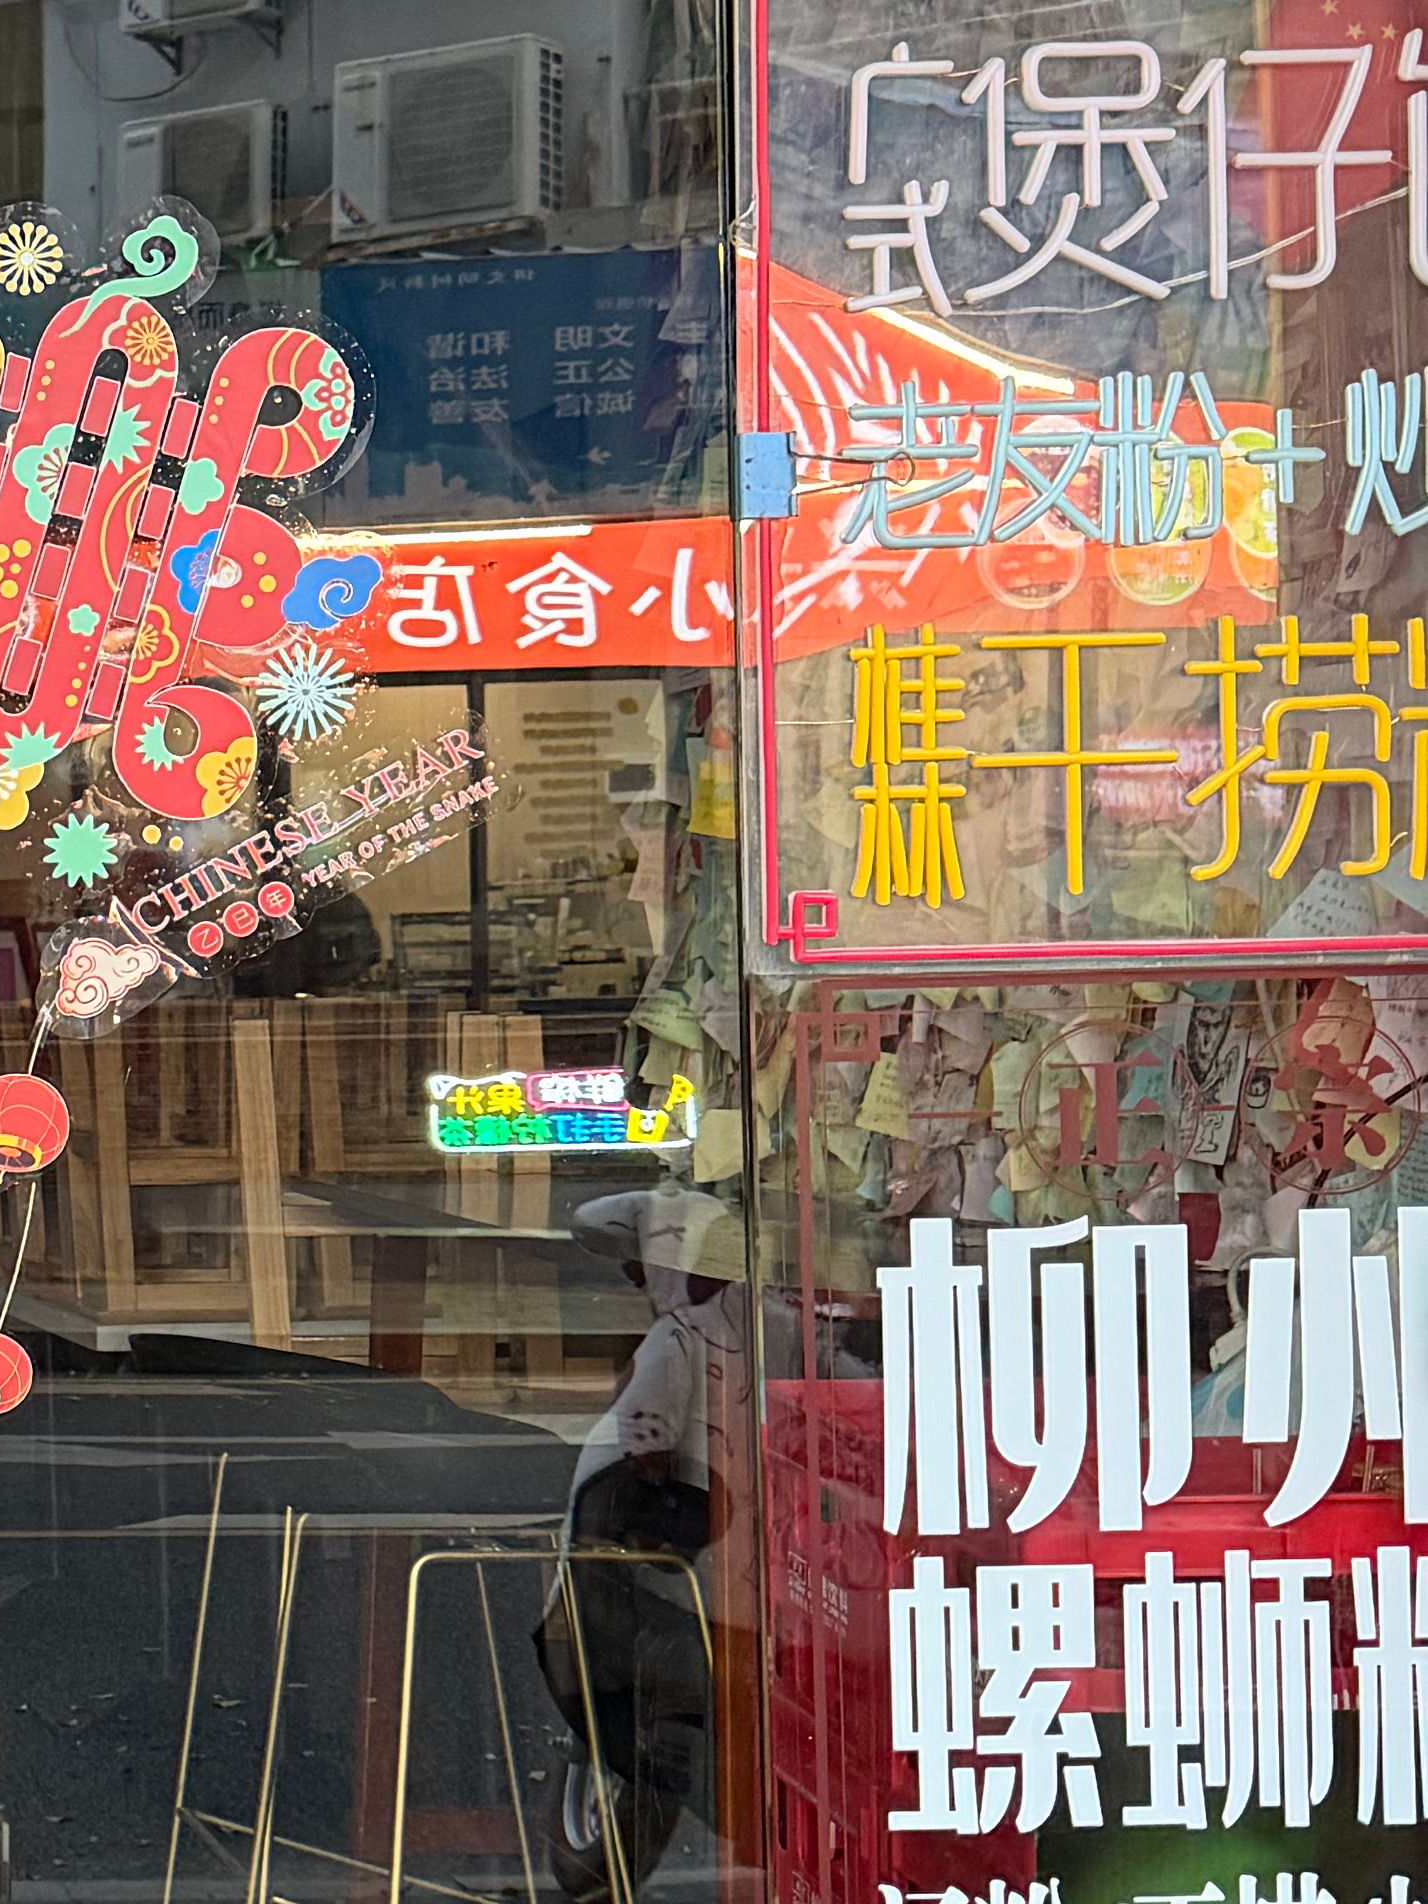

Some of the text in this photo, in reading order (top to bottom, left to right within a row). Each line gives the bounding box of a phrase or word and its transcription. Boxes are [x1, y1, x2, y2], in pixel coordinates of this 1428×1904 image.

[843, 27, 1428, 317] 广式 煲仔
[129, 728, 486, 935] CHINESE YEAR
[301, 775, 501, 890] YEAR OF THE SNAKE
[970, 612, 1428, 896] 干捞
[192, 886, 291, 954] 乙巳年
